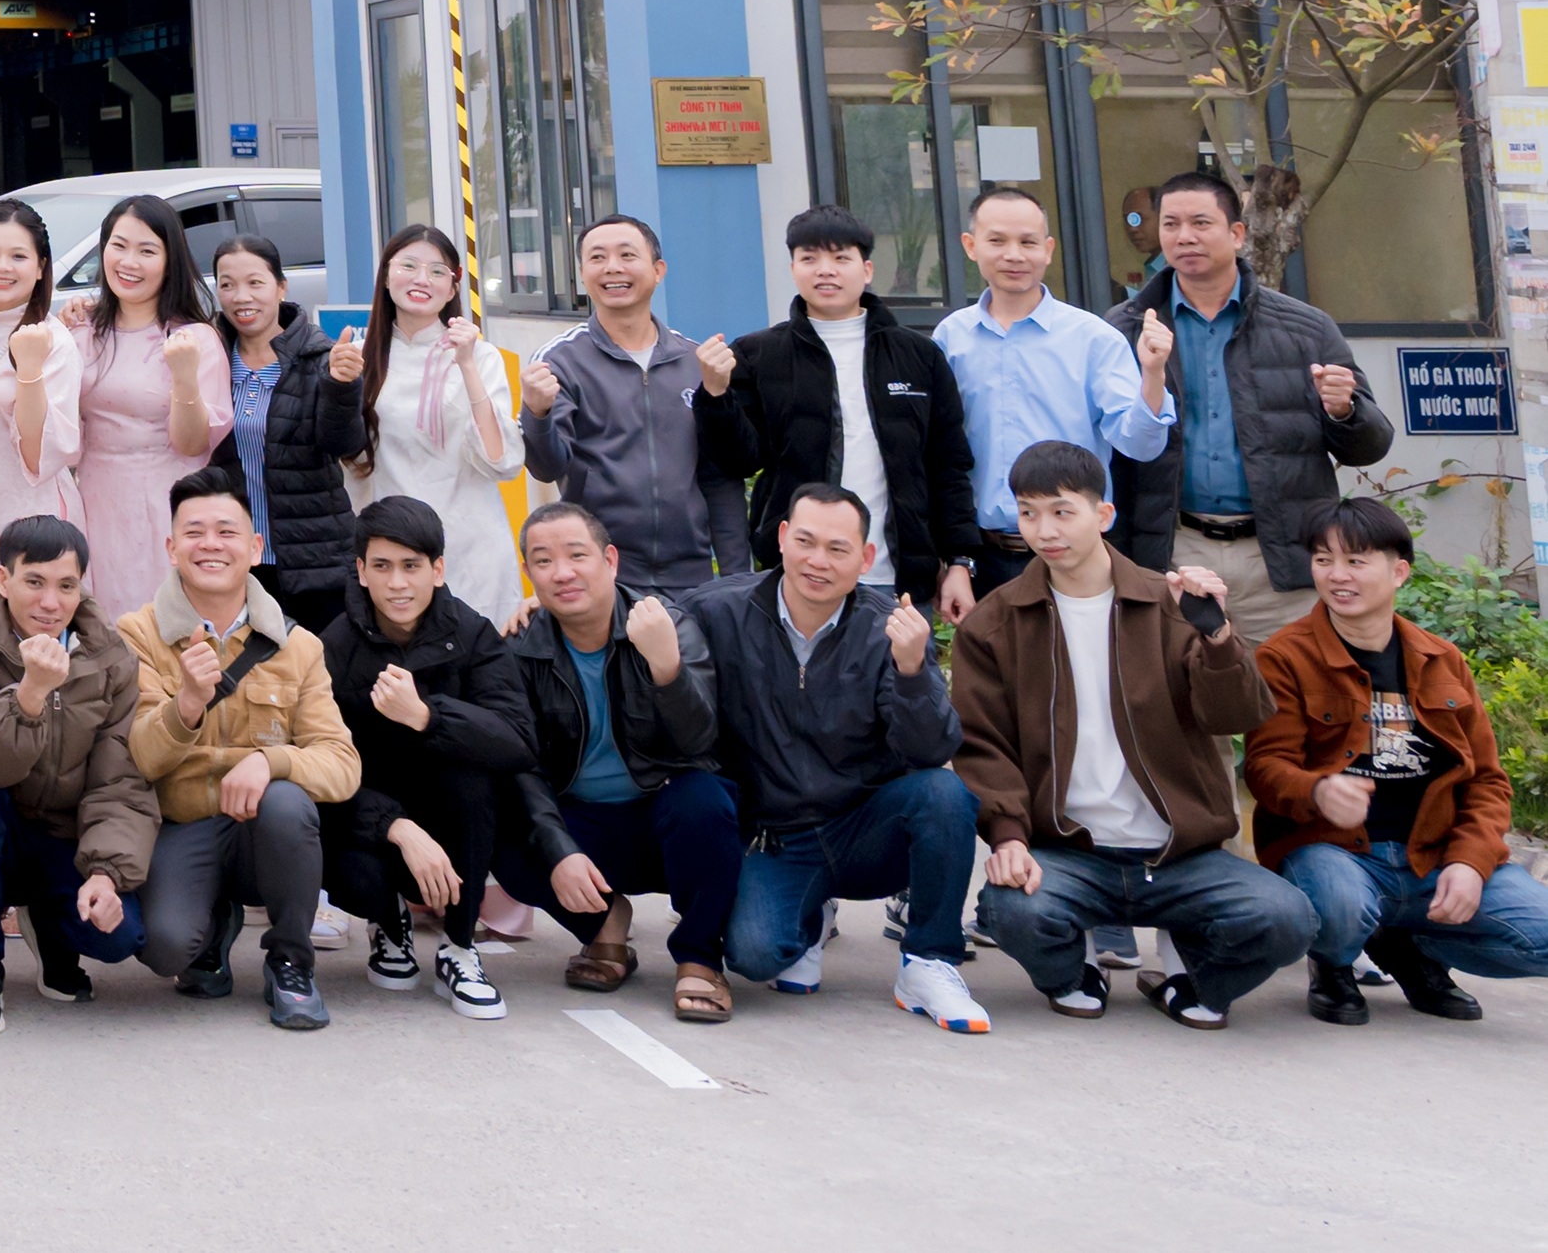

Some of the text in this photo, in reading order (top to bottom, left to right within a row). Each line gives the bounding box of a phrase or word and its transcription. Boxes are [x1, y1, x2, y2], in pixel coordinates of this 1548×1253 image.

[707, 102, 716, 112] TY
[1408, 361, 1502, 385] HỐ GA THOÁT
[1420, 394, 1500, 416] NƯỚC MƯA
